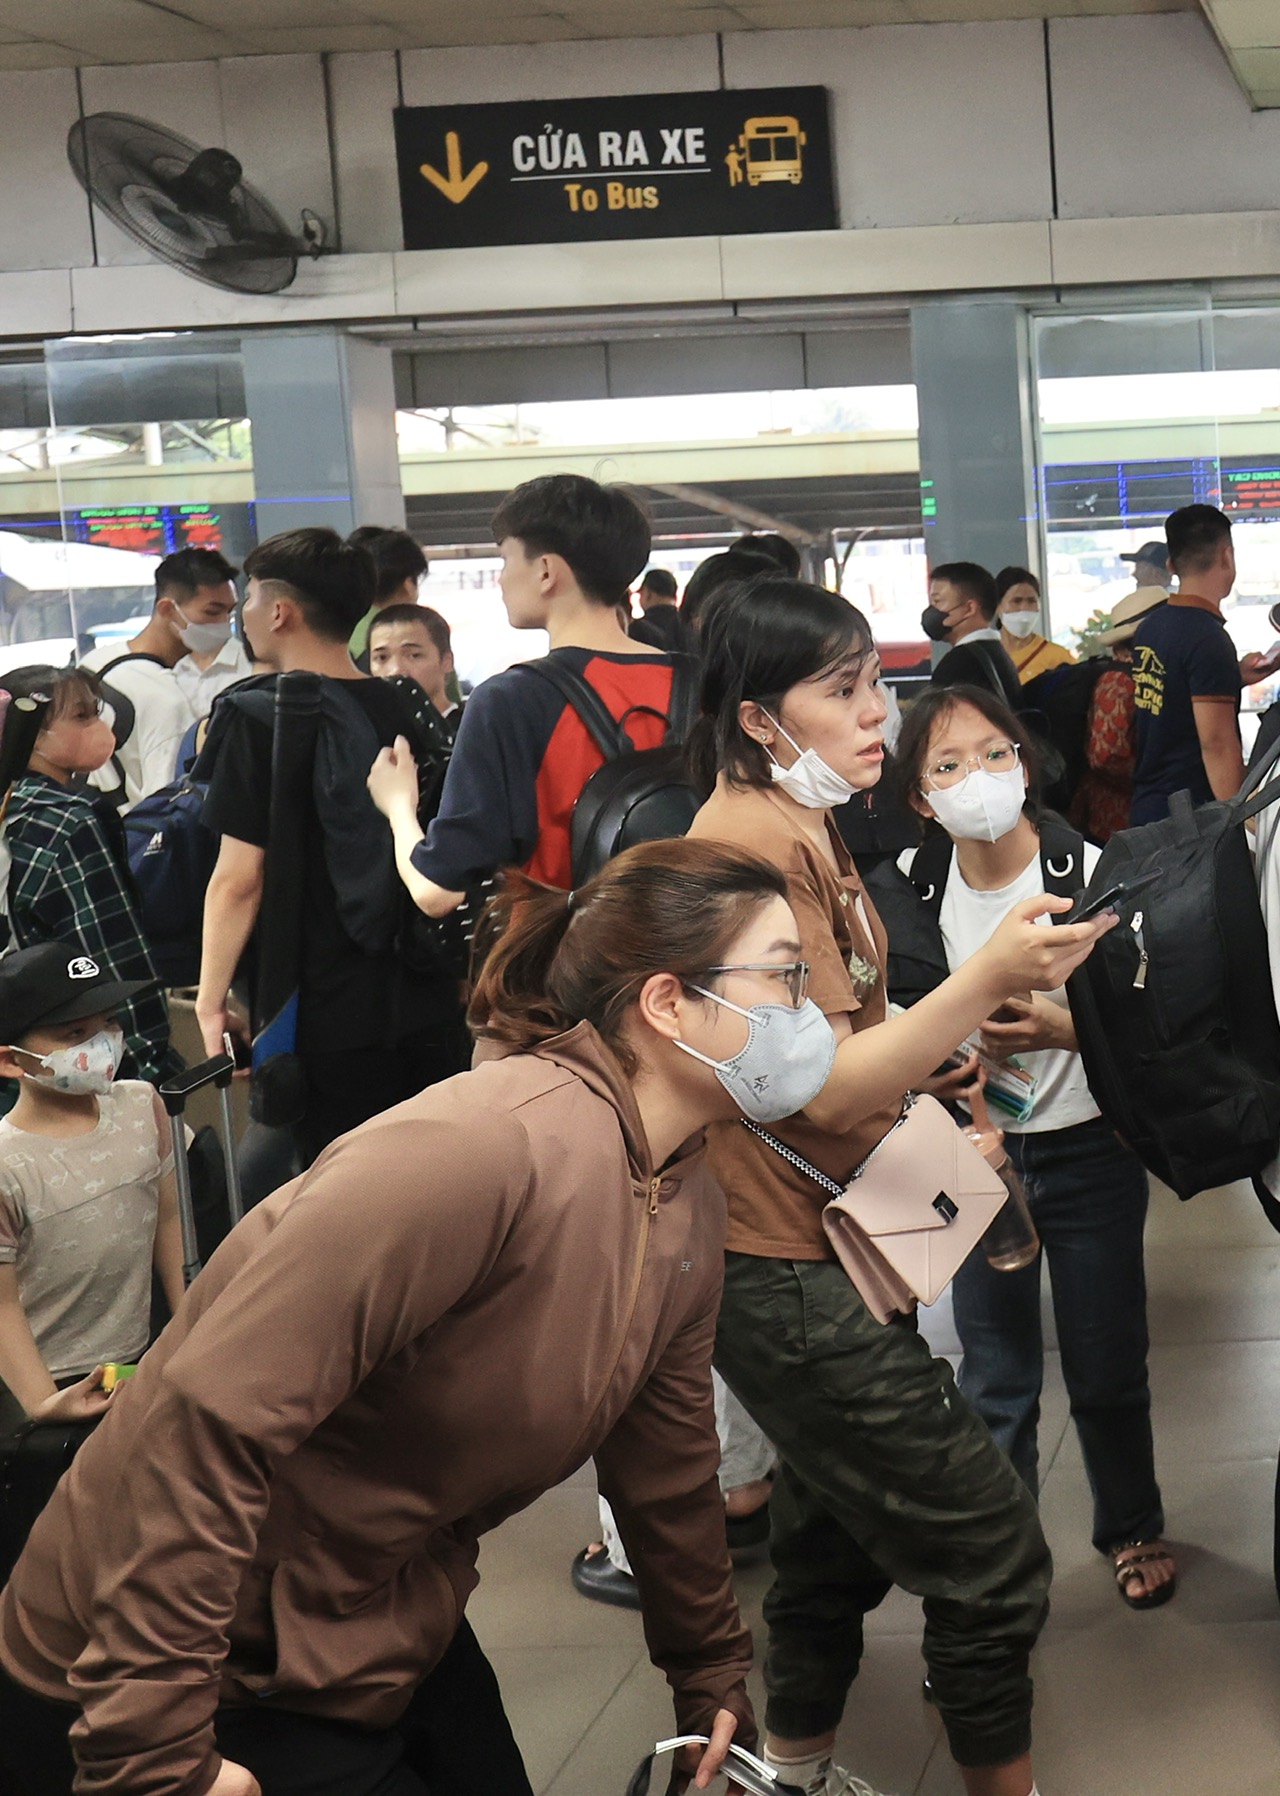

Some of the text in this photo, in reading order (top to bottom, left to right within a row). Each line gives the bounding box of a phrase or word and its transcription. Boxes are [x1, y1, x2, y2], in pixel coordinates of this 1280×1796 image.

[512, 123, 706, 172] CỬA RA XE
[564, 182, 659, 212] To Bus
